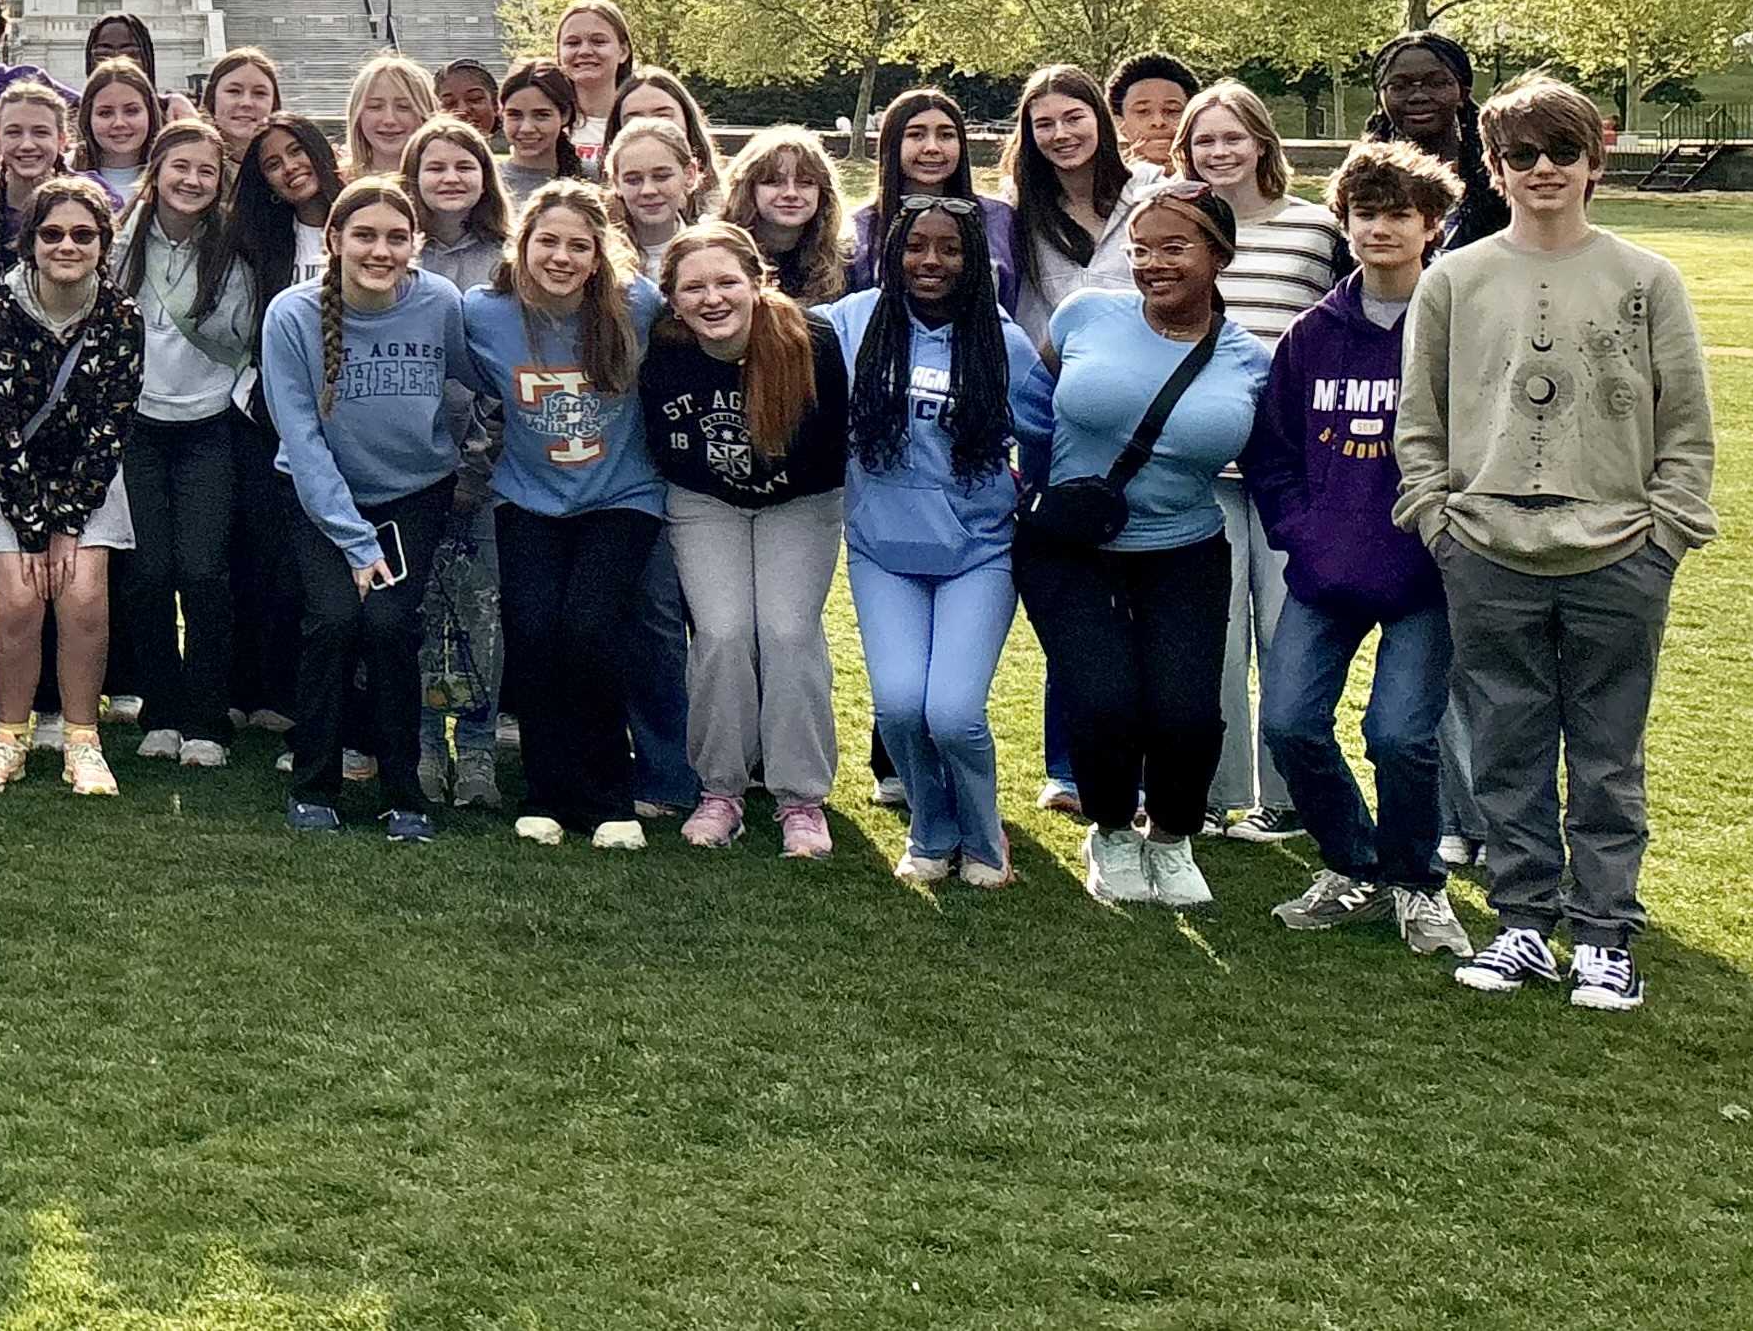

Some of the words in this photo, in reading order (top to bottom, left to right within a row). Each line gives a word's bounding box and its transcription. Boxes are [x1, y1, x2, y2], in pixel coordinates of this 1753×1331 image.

[370, 342, 444, 360] AGNES
[662, 393, 703, 421] ST.
[670, 432, 689, 450] 18
